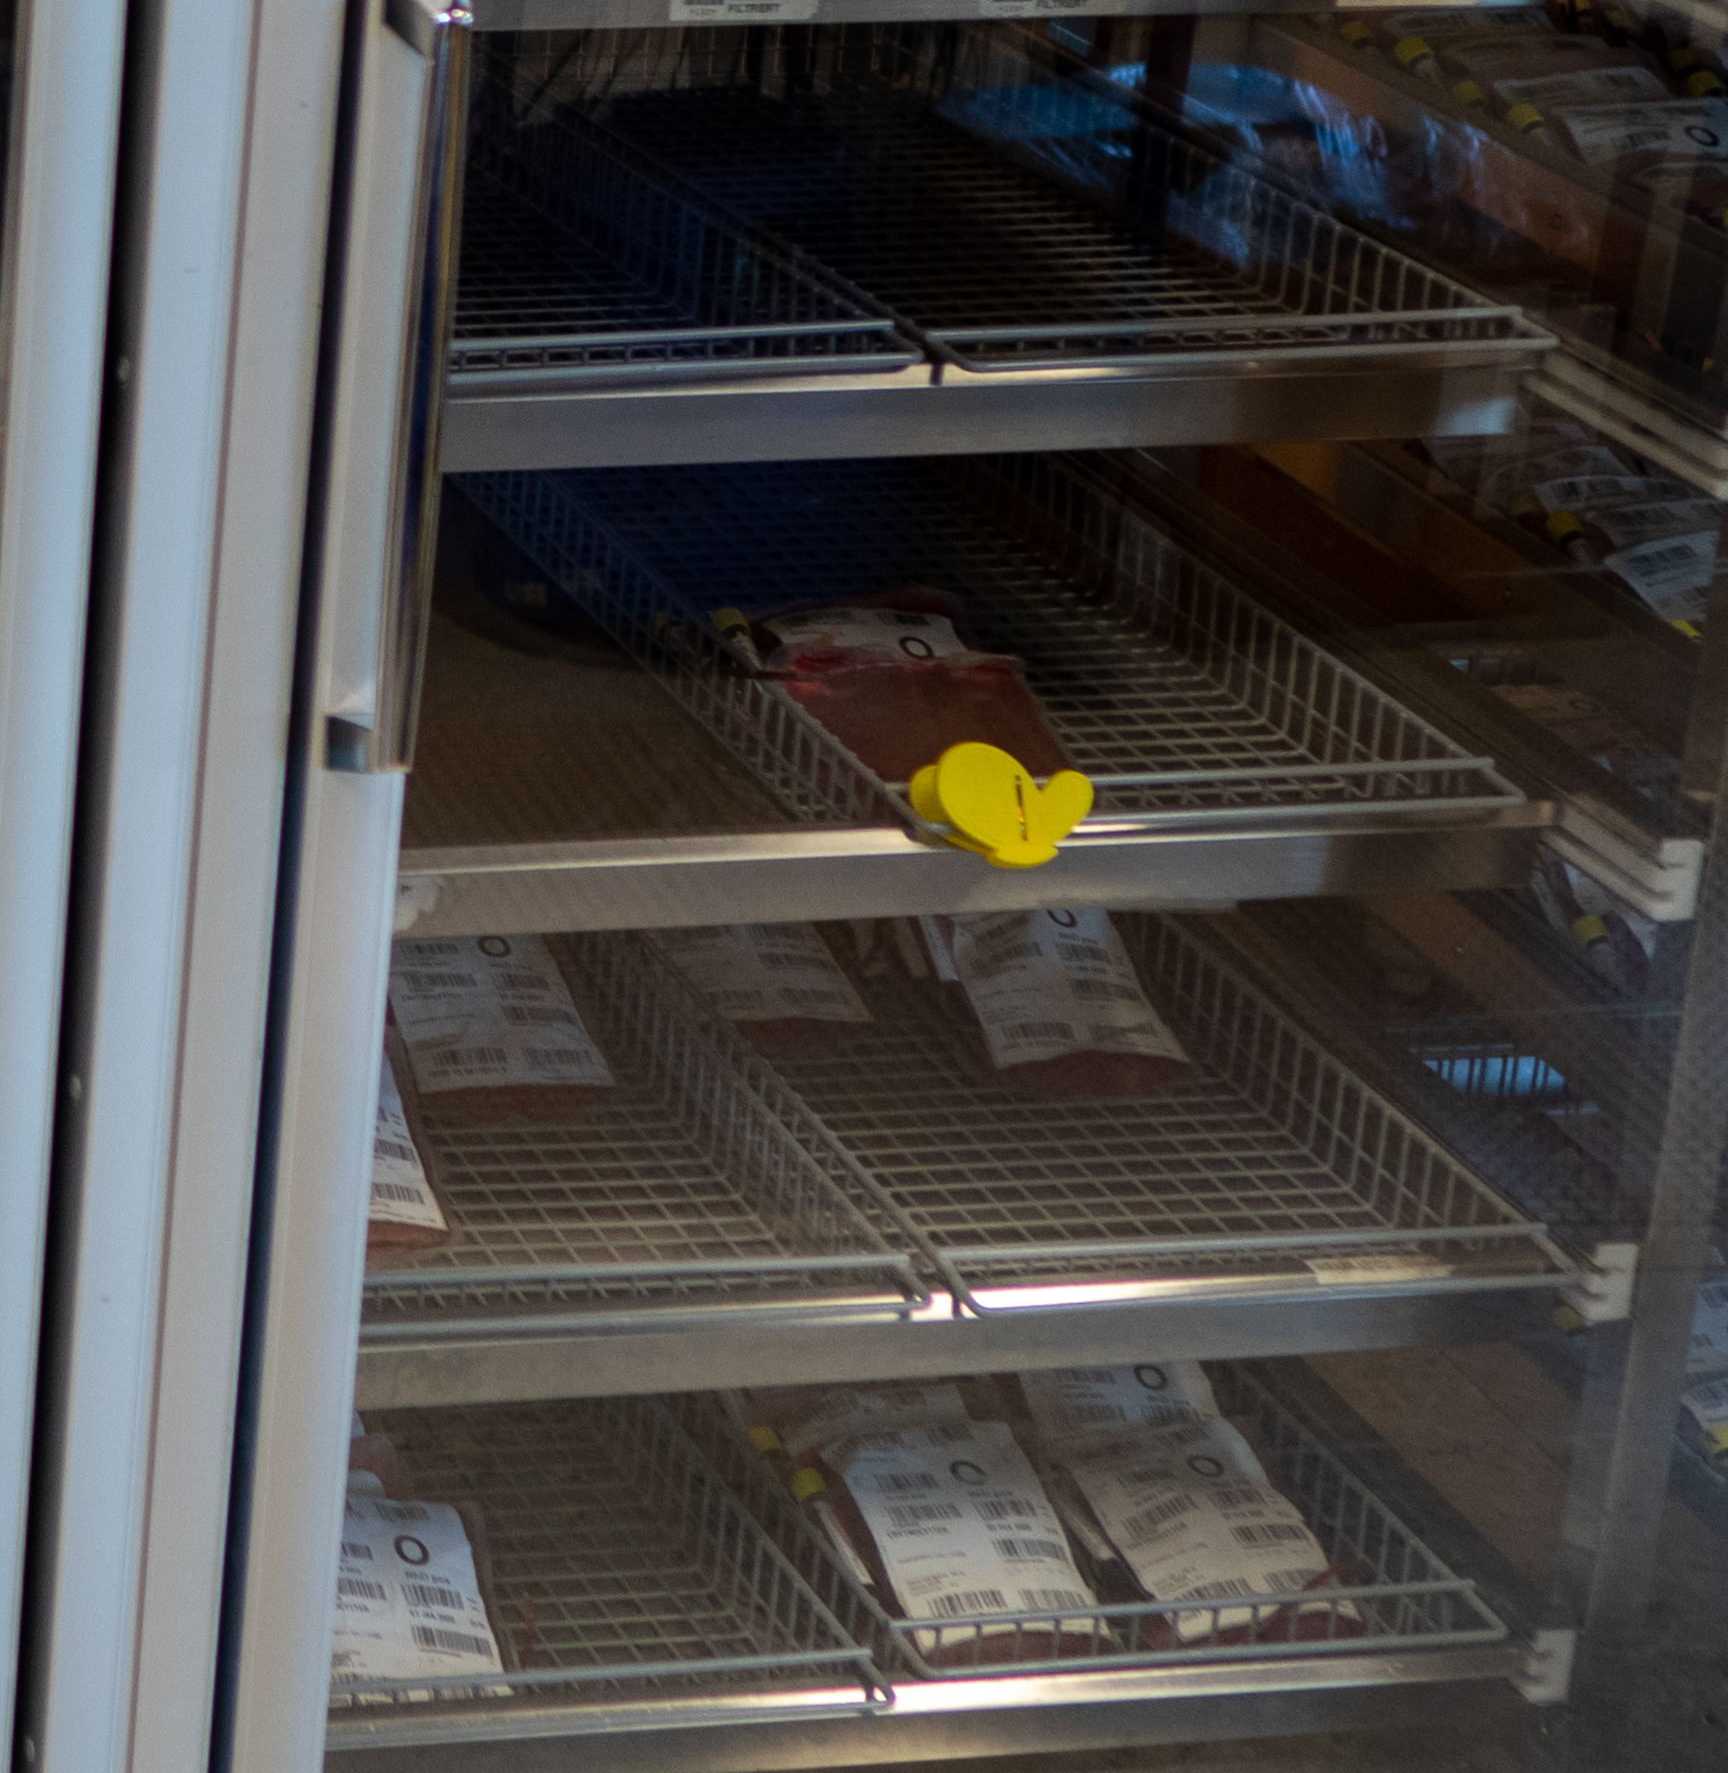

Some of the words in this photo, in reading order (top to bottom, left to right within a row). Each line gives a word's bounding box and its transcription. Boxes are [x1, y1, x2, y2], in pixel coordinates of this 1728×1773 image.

[898, 634, 934, 660] O
[476, 935, 512, 959] O
[1132, 1363, 1169, 1392] O
[393, 1534, 430, 1566] O
